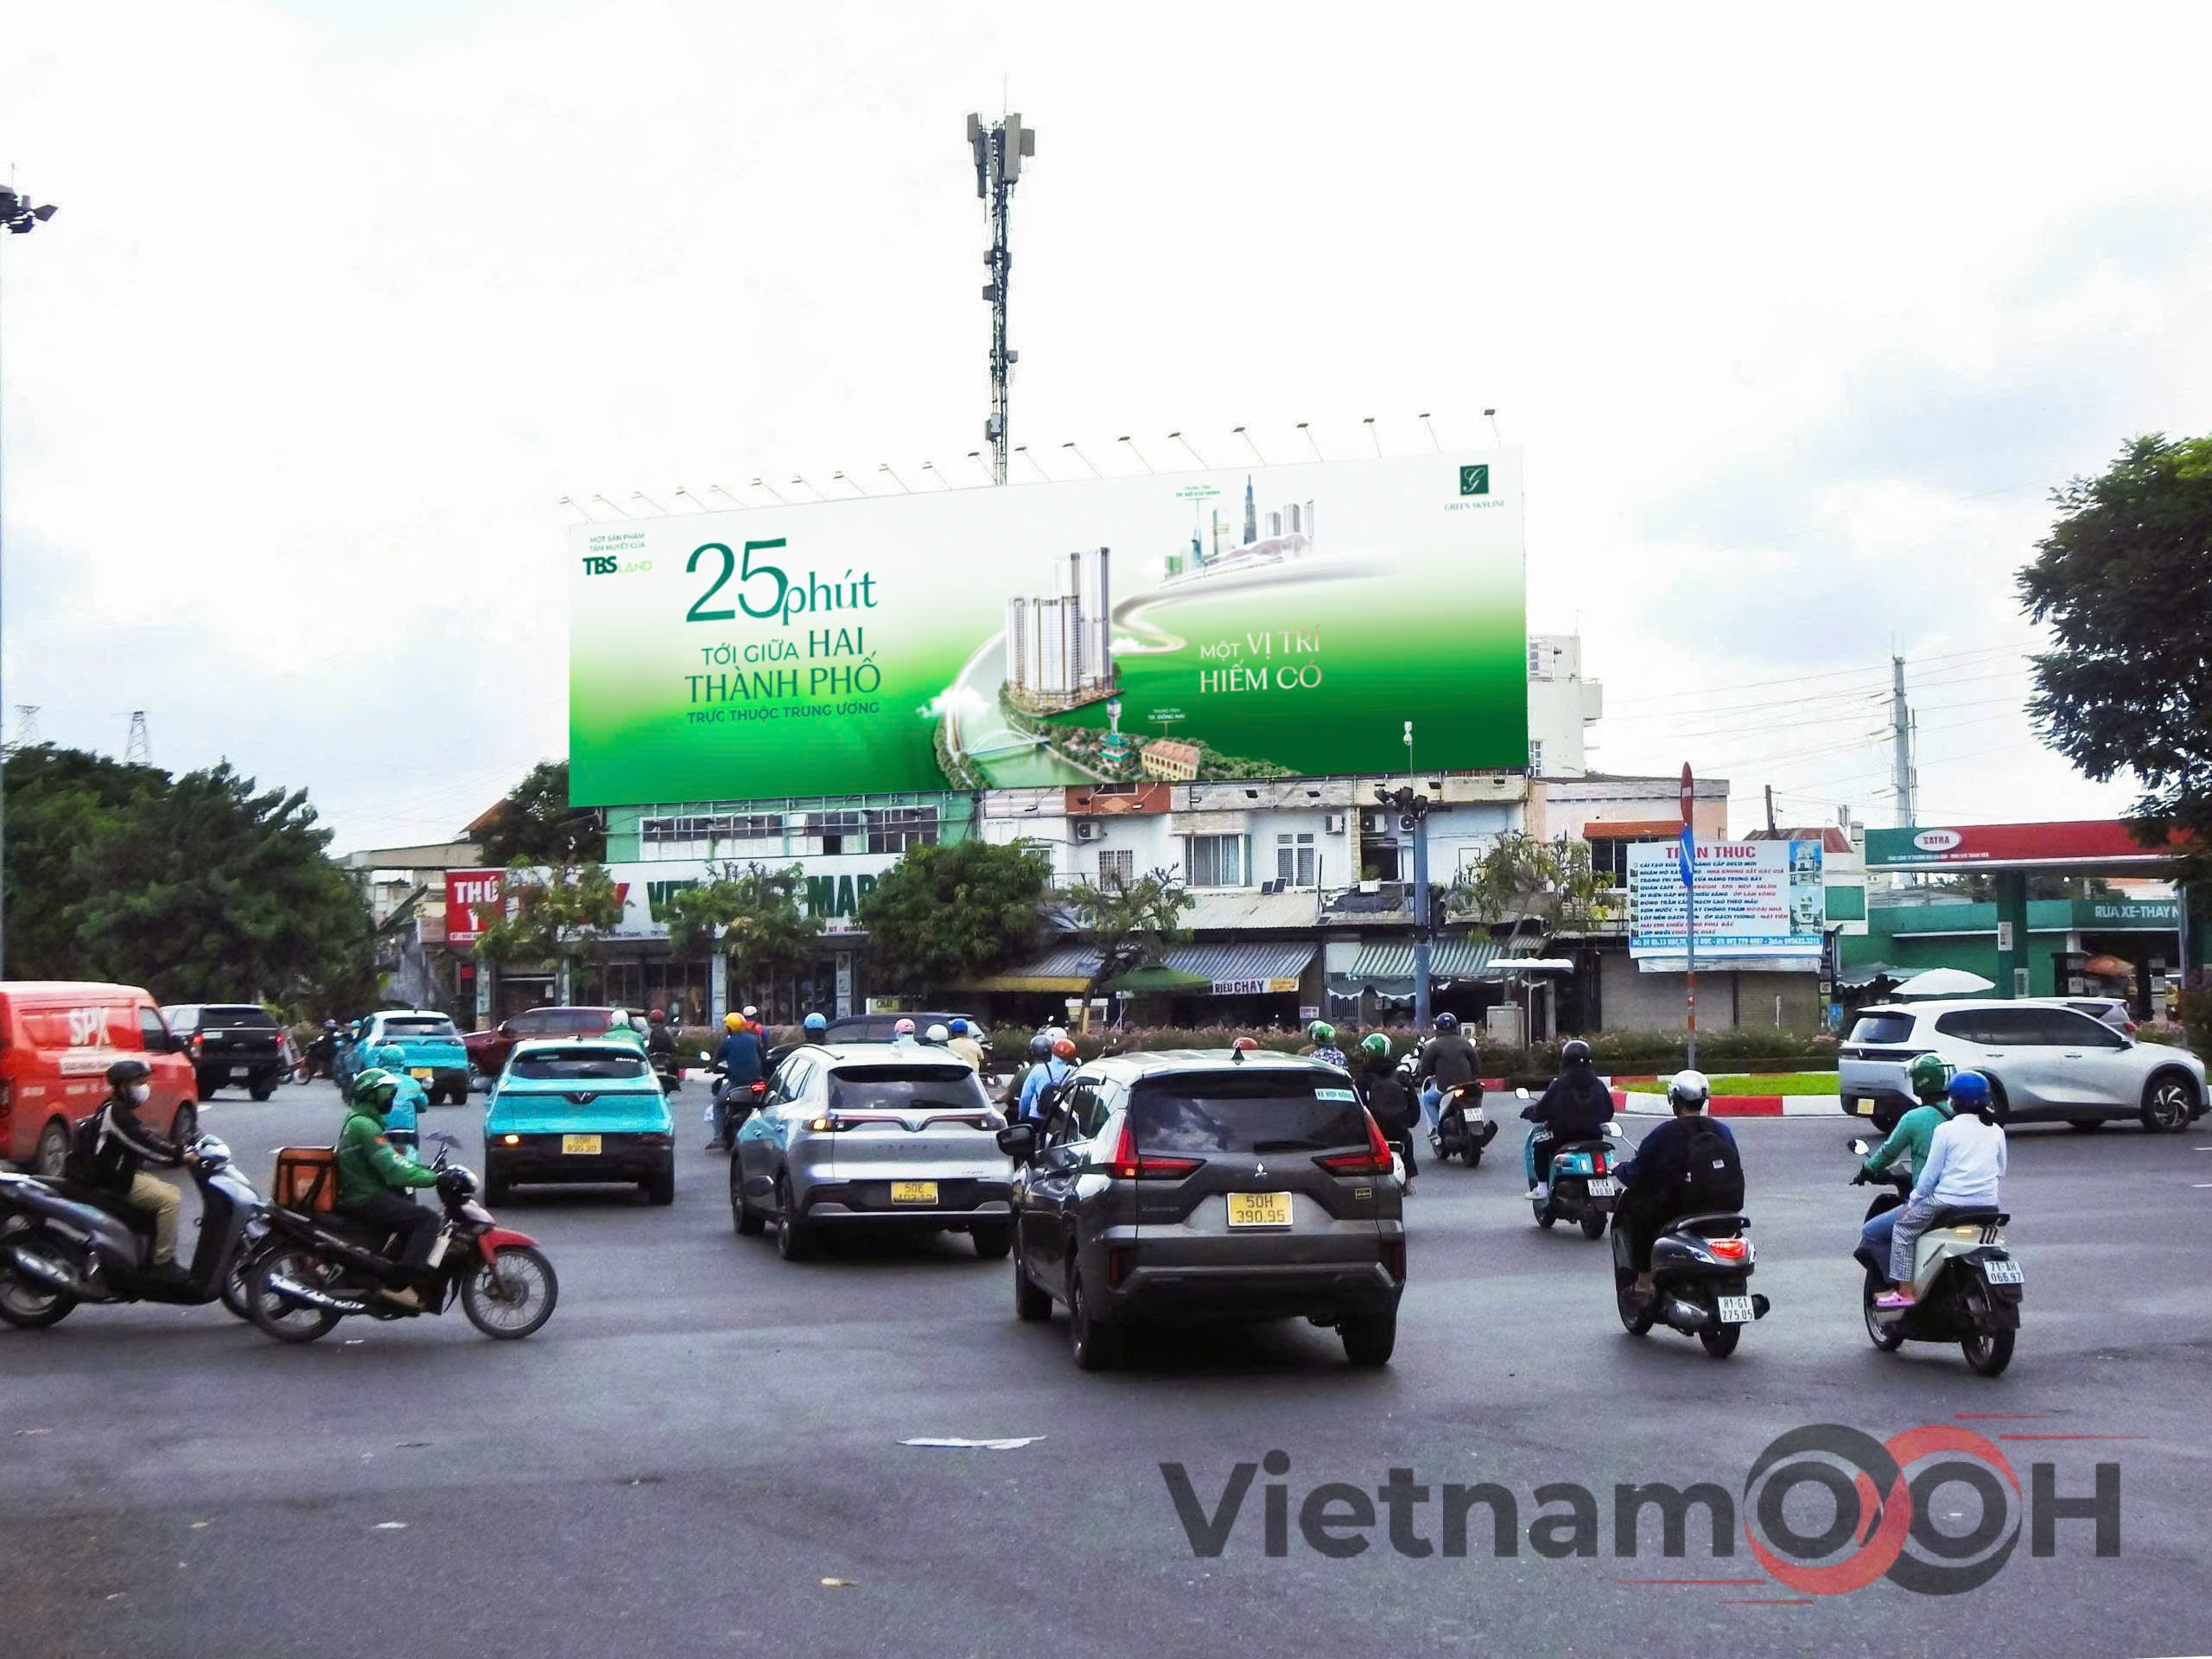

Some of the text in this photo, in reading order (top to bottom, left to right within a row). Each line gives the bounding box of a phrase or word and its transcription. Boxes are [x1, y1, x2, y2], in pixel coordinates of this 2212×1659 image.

[1471, 499, 1505, 508] SKYLINE
[582, 556, 618, 575] TBS
[782, 569, 879, 626] phút
[701, 626, 864, 665] TỚI GIỮA HAI
[1200, 623, 1320, 662] MỘT VỊ TRÍ
[684, 651, 881, 703] THÀNH PHỐ
[1200, 658, 1323, 693] HIẾM CÓ
[687, 700, 879, 726] TRỰC THUỘC TRUNG ƯƠNG
[1923, 836, 1950, 845] SATRA
[454, 876, 499, 904] THÚ
[1234, 980, 1265, 994] CHAY
[70, 1007, 111, 1050] SPX
[1246, 1195, 1274, 1208] 50H
[1236, 1210, 1286, 1224] 390.95
